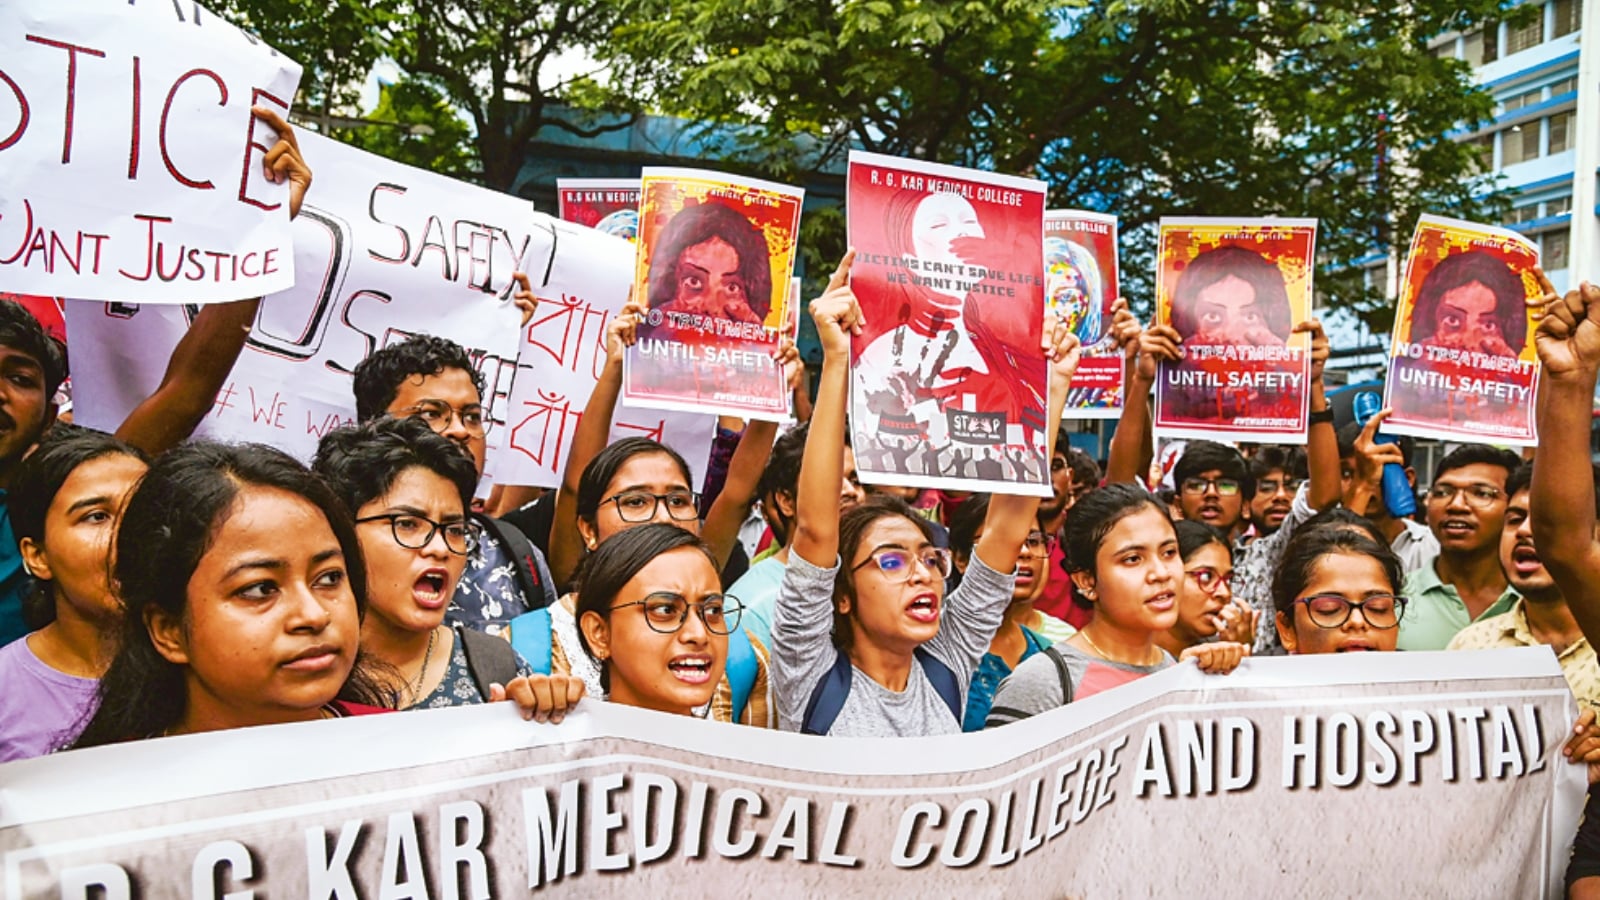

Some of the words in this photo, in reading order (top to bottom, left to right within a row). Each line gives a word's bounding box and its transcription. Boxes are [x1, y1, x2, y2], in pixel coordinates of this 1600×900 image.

[606, 192, 641, 204] MEDICA
[871, 170, 882, 185] R.
[901, 174, 923, 191] KAR
[927, 179, 974, 199] MEDICAL
[977, 187, 1023, 207] COLLEGE
[368, 182, 531, 301] SAFETY
[1045, 220, 1073, 231] DICAL
[118, 214, 279, 282] JUSTICE
[855, 252, 920, 270] VICTIMS
[923, 262, 965, 276] CAN'T
[968, 267, 1007, 282] SAVE
[1009, 272, 1042, 287] LIFE
[887, 272, 907, 284] WE
[911, 275, 952, 290] WANT
[956, 279, 1016, 298] JUSTICE
[667, 310, 778, 343] TREATMENT
[638, 337, 700, 361] UNTIL
[704, 345, 777, 369] SAFETY
[1189, 344, 1303, 362] TREATMENT
[1397, 341, 1423, 359] NO
[1426, 345, 1534, 375] TREATMENT
[1168, 370, 1224, 387] UNTIL
[1227, 371, 1303, 388] SAFETY
[1400, 366, 1456, 391] UNTIL
[1459, 376, 1530, 401] SAFETY
[249, 385, 287, 430] WE
[306, 410, 352, 438] WA
[305, 800, 491, 900] KAR
[522, 772, 859, 889] MEDICAL
[890, 736, 1130, 868] COLLEGE
[1132, 716, 1256, 797] AND
[1282, 704, 1547, 789] HOSPITAL
